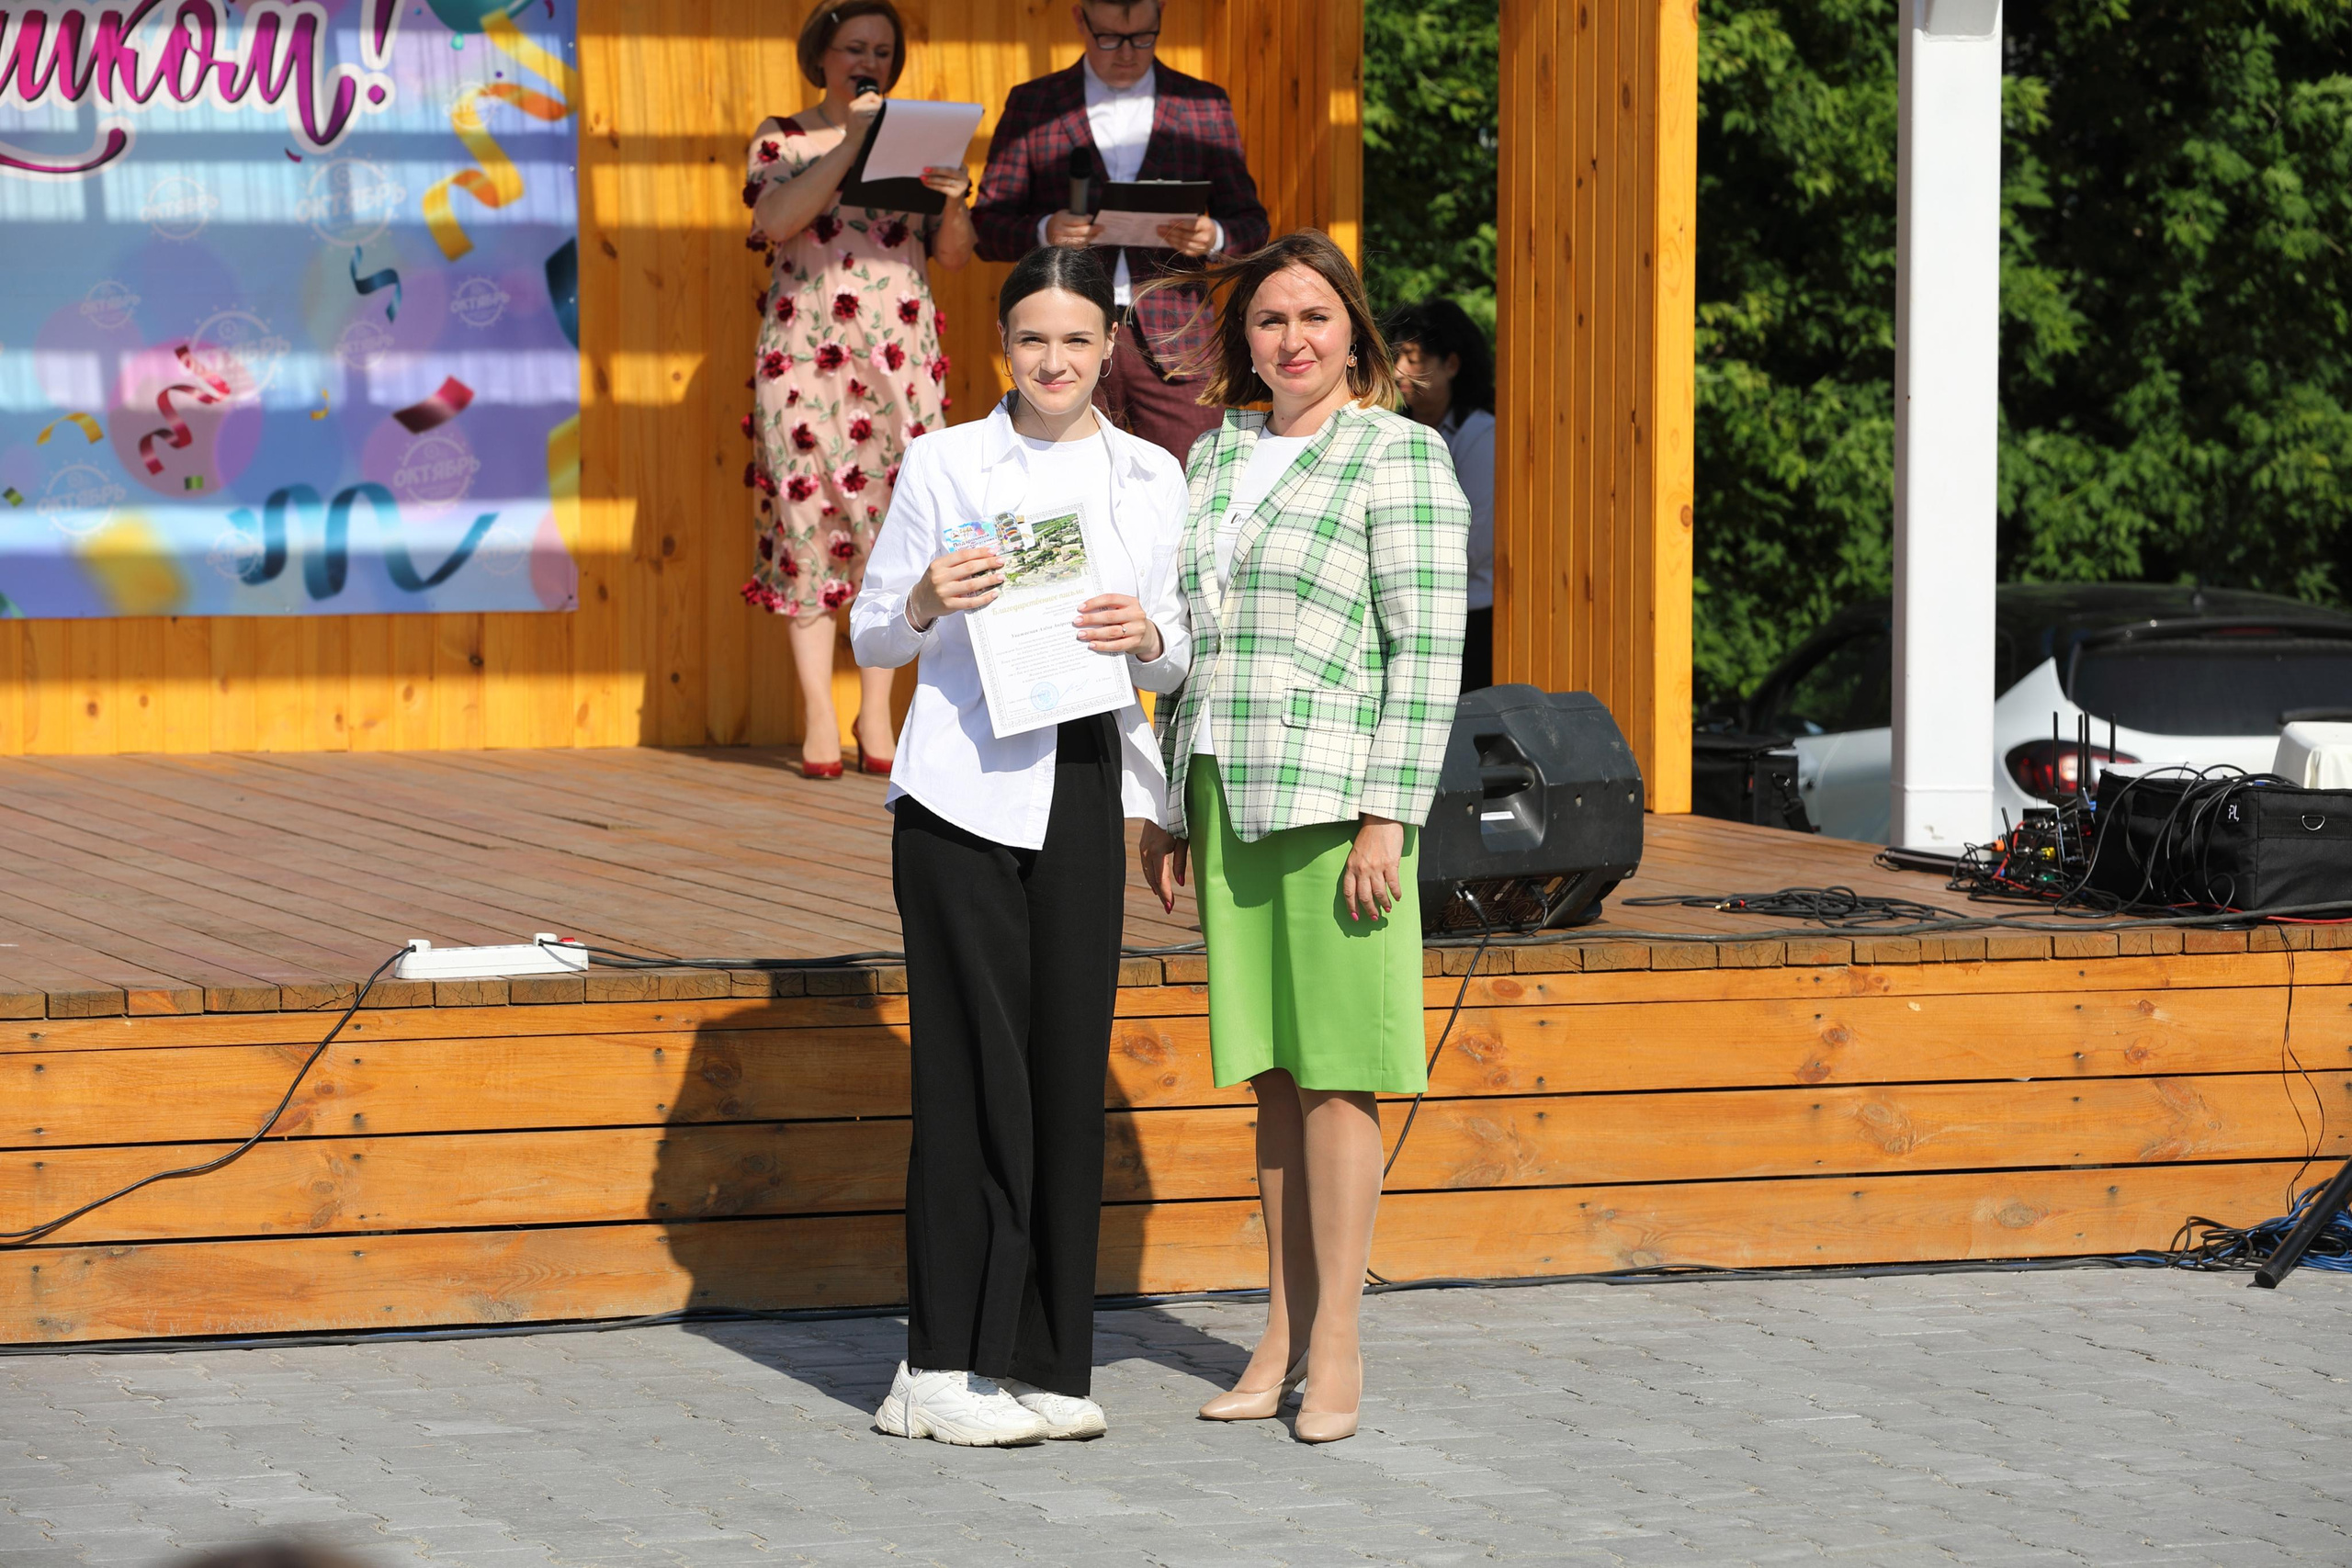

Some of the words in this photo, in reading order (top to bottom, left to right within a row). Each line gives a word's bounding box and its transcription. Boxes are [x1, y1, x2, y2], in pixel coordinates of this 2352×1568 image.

[295, 180, 407, 223] ОКТЯБРЬ
[392, 454, 481, 488] ОКТЯБРЬ
[36, 481, 127, 516] ОКТЯБРЬ
[992, 595, 1058, 616] Благодарственное
[1058, 588, 1085, 599] письмо
